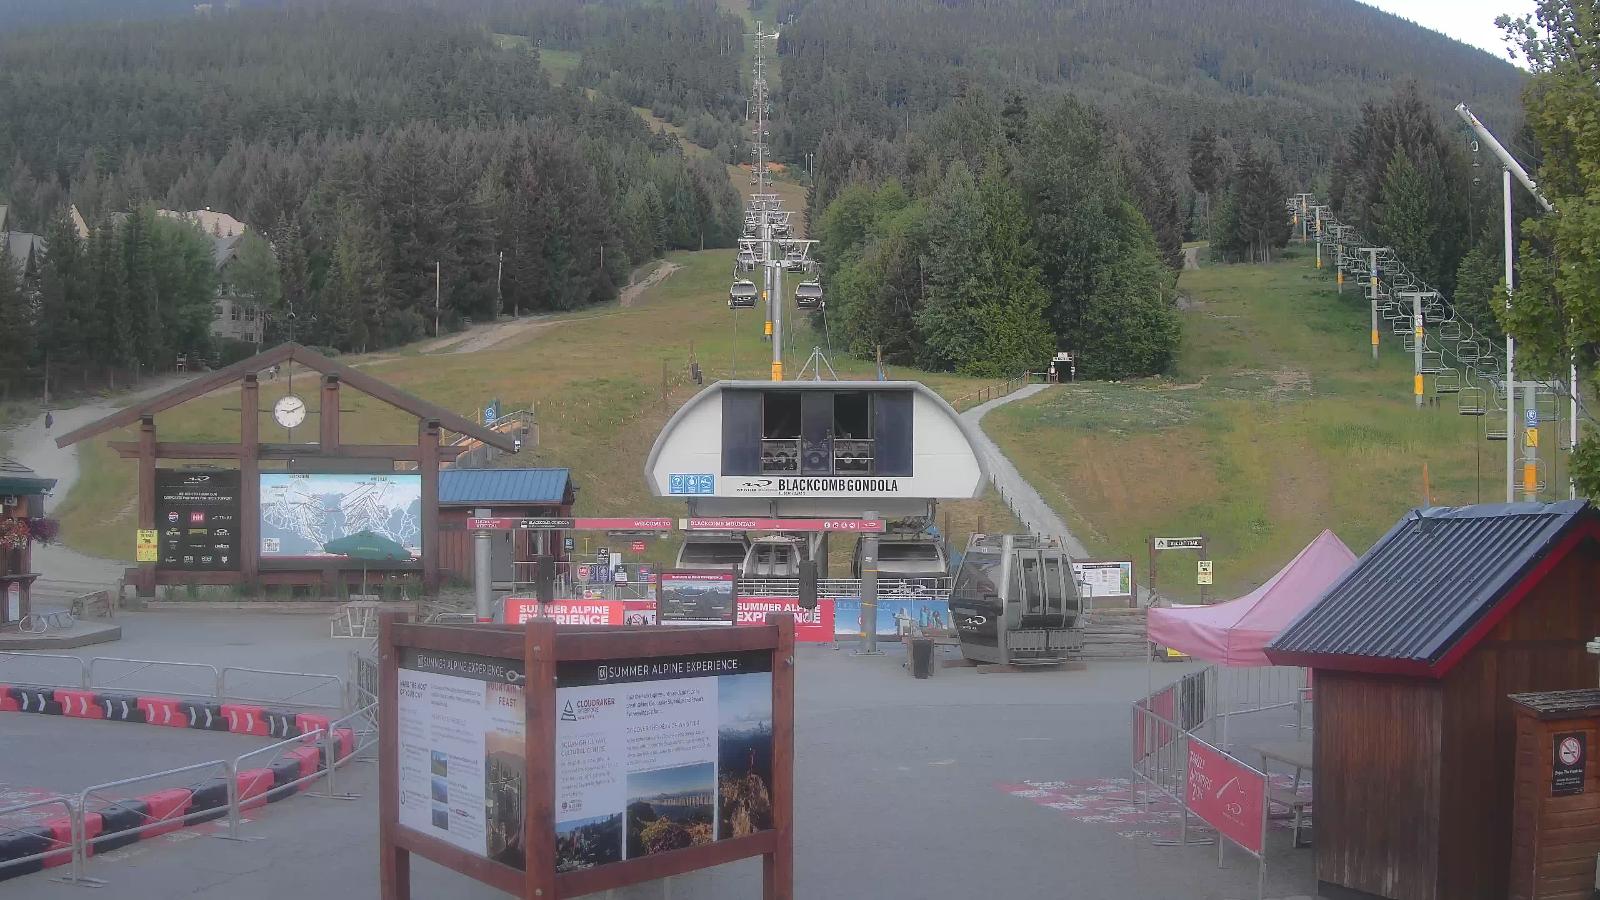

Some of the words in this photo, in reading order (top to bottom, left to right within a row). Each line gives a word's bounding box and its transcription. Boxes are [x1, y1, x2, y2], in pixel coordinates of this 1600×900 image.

[779, 479, 845, 491] BLACKCOMB
[848, 479, 898, 492] GONDOLA
[569, 605, 609, 614] ALPINE
[736, 602, 782, 612] SUMMER
[784, 604, 820, 613] ALE
[518, 614, 609, 625] ERIENCE
[736, 611, 821, 624] EXPNCE
[423, 656, 446, 669] SUMMER
[447, 659, 467, 672] ALPINE
[468, 663, 504, 678] EXPERIENCE
[609, 665, 649, 678] SUMMER
[652, 662, 684, 675] ALPINE
[686, 659, 738, 673] EXPERIENCE
[499, 696, 516, 708] FEAST
[577, 698, 615, 708] CLOUDRAKER
